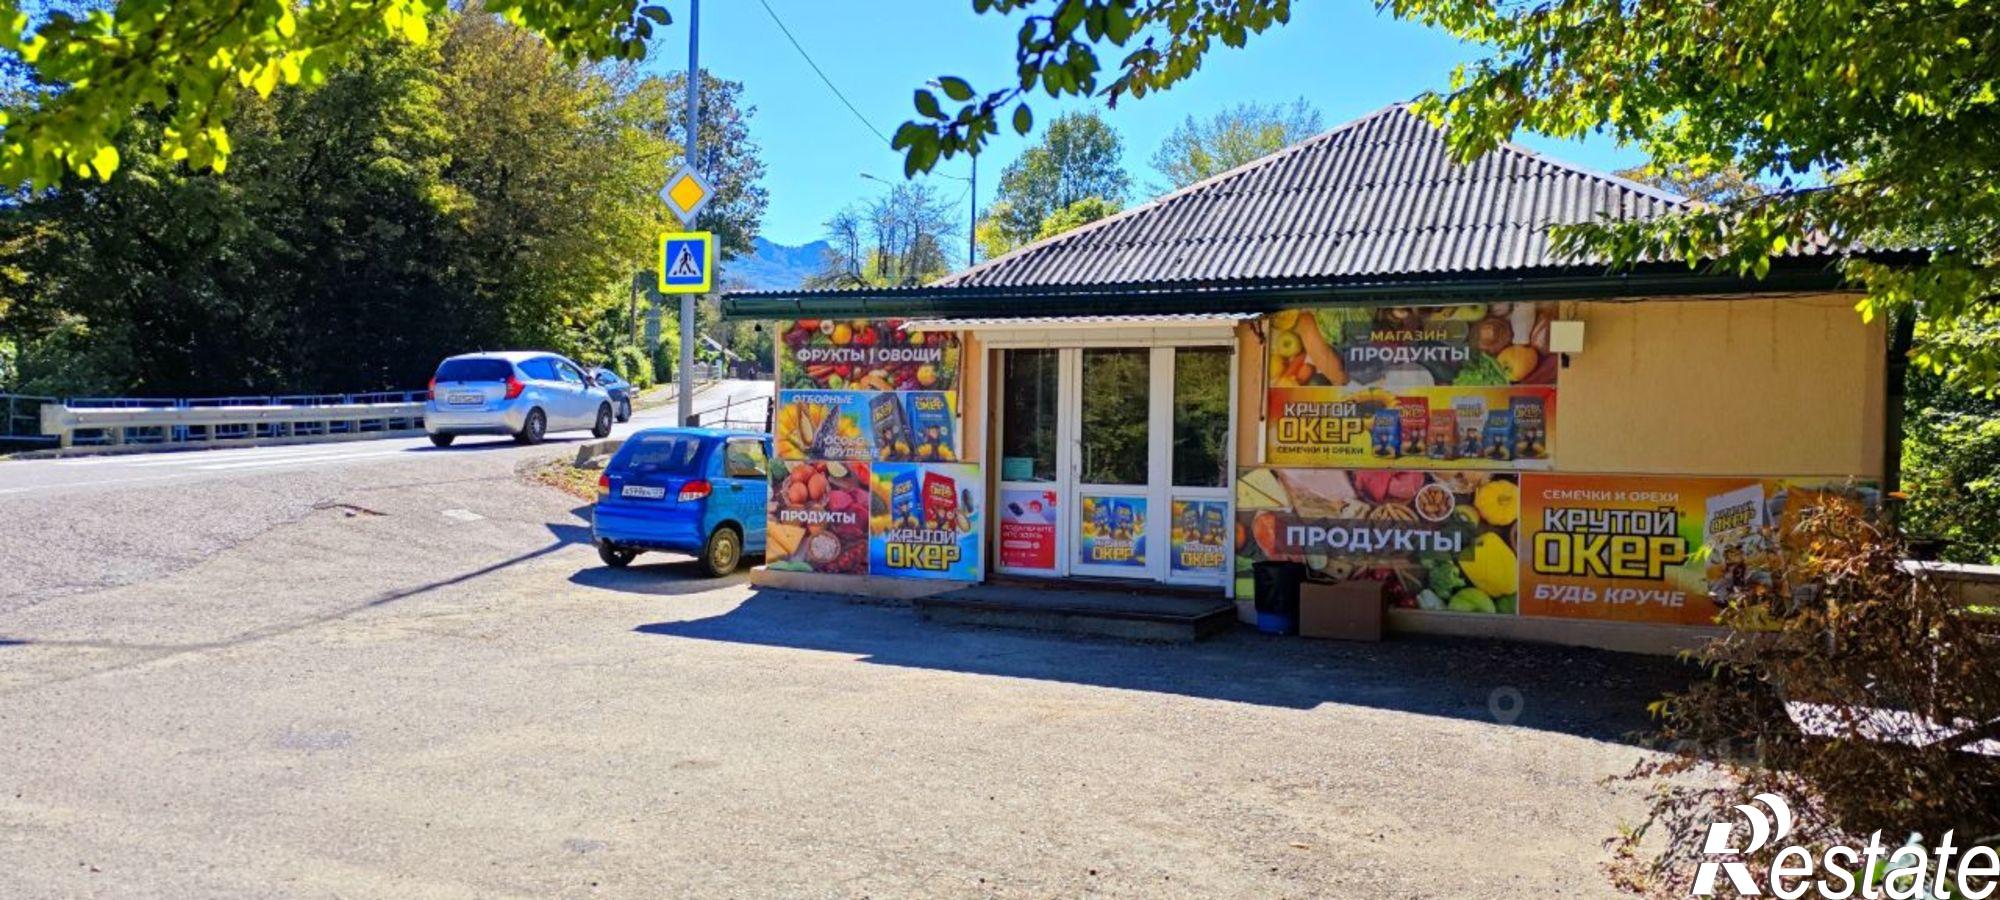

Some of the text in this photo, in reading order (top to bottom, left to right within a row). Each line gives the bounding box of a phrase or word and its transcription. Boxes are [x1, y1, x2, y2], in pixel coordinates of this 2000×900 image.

[1370, 330, 1447, 341] МАГАЗИН
[797, 348, 865, 362] ФРУКТЫ
[878, 348, 941, 362] ОВОЩИ
[1350, 346, 1470, 363] ПРОДУКТЫ
[792, 394, 854, 405] ОТБОРНЫЕ
[1284, 400, 1357, 417] КРУТОЙ
[1277, 446, 1320, 454] СЕМЕЧКИ
[1543, 490, 1679, 502] СЕМЕЧКИ И ОРЕХИ
[780, 510, 856, 524] ПРОДУКТЫ
[1543, 506, 1678, 536] КРУТОЙ
[890, 529, 955, 545] КРУТОЙ
[1286, 526, 1462, 553] ПРОДУКТЫ
[1534, 584, 1686, 607] БУДЬ КРУЧЕ
